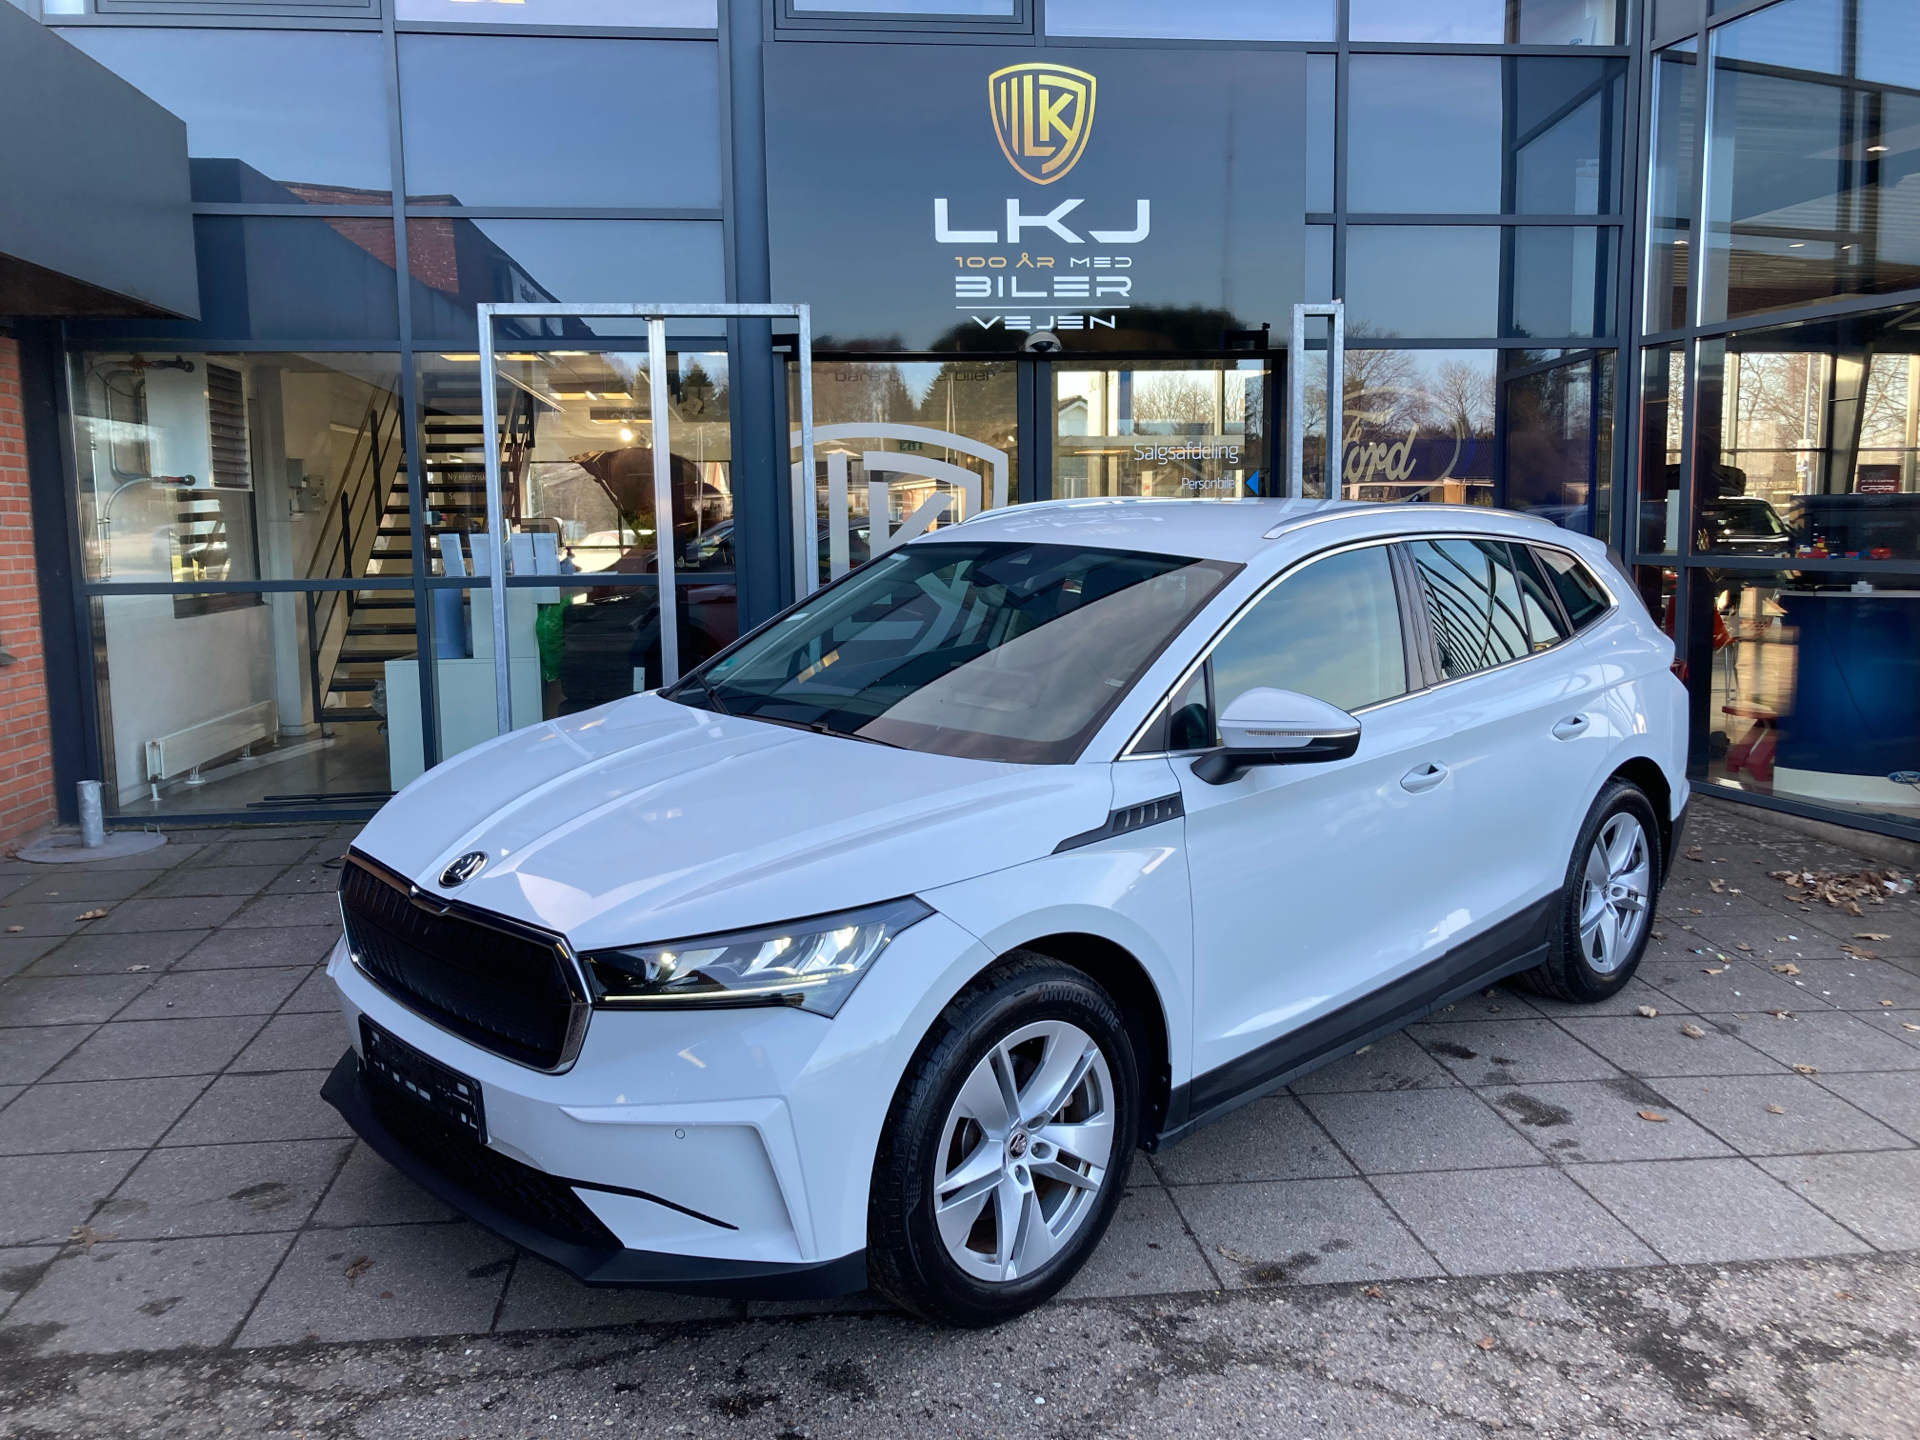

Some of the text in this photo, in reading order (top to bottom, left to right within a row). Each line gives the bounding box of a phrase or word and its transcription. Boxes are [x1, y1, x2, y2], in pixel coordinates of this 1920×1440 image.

[934, 198, 1150, 243] LKJ
[955, 252, 1132, 268] 100 ÅR MED
[955, 276, 1132, 298] BILER
[971, 315, 1116, 330] VEJEN
[1133, 441, 1239, 465] Salgsafdeling
[1037, 982, 1120, 1032] BRIDGESTONE
